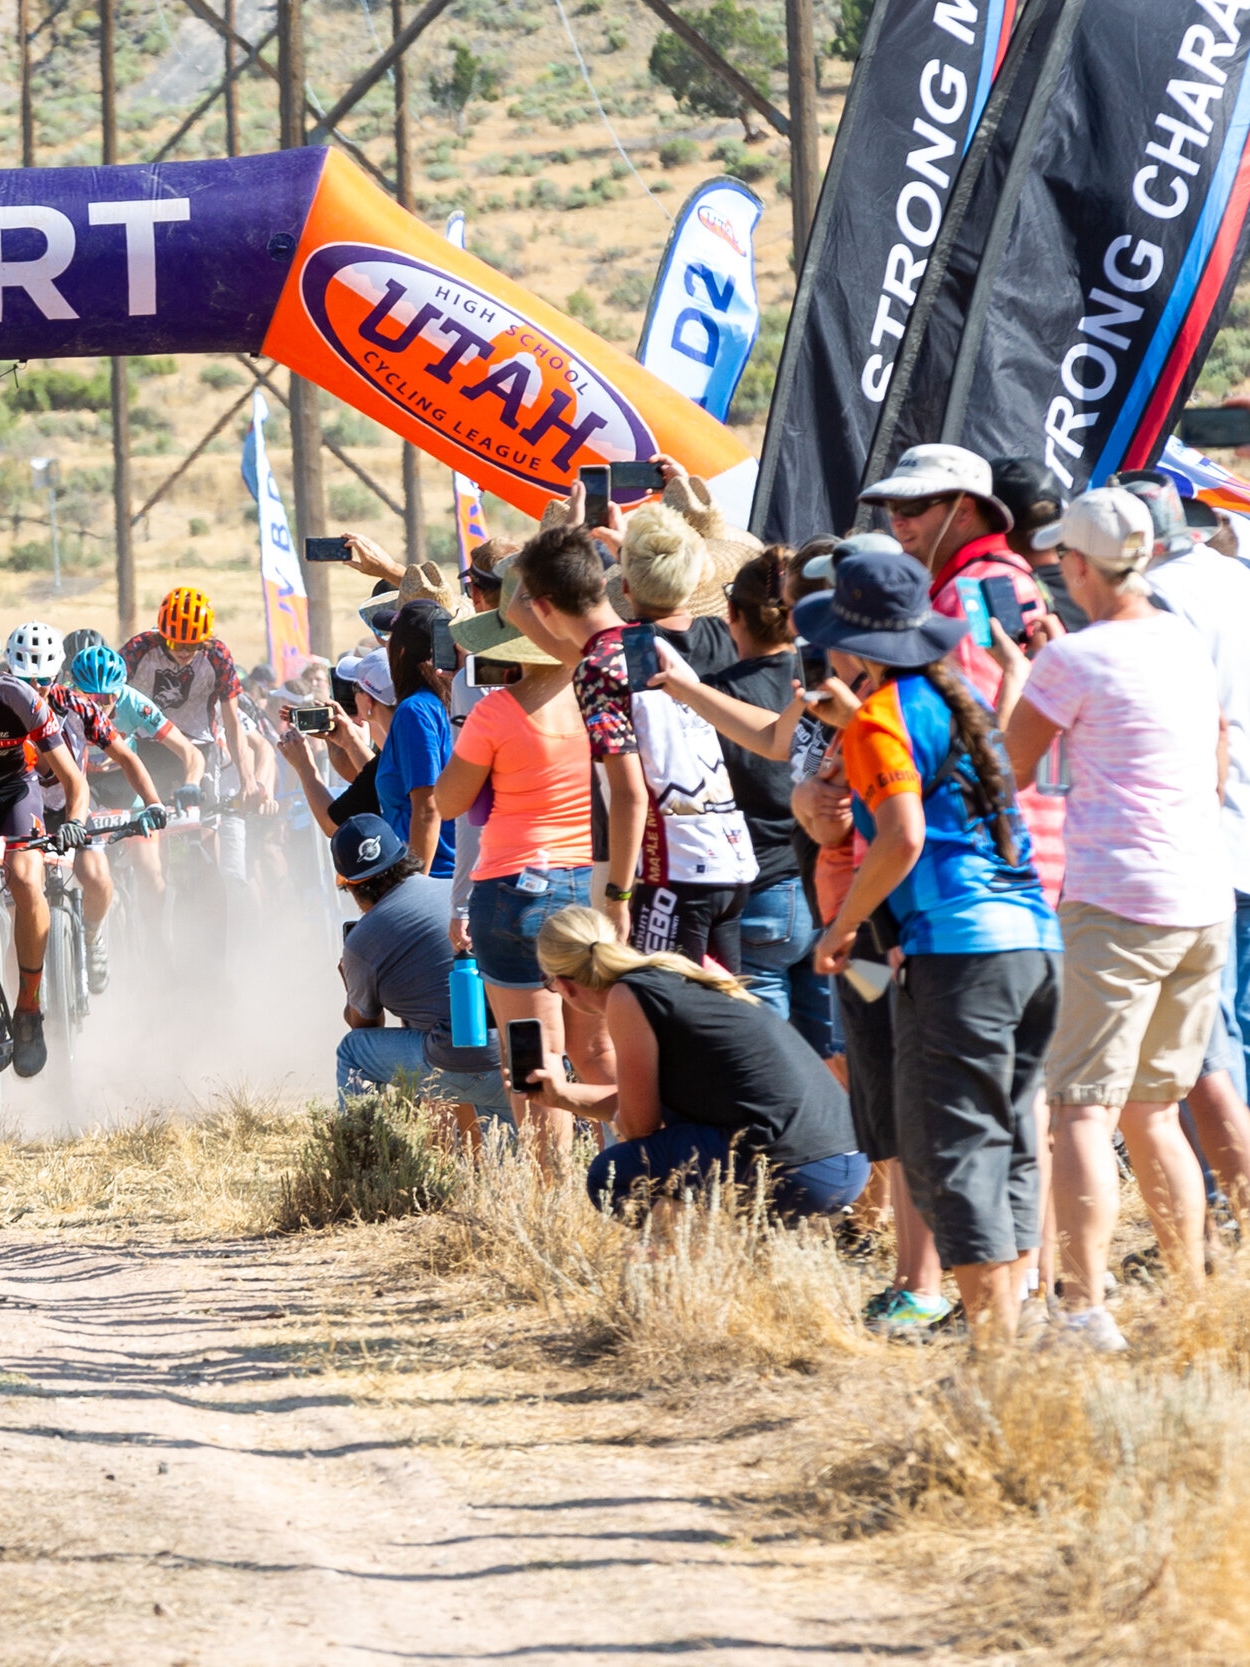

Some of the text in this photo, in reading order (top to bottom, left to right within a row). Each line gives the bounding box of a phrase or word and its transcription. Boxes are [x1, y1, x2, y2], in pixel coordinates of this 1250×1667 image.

[861, 58, 968, 403] STRONG
[435, 285, 589, 395] HIGH SCHOOL
[671, 263, 736, 369] D2
[1044, 234, 1164, 489] TRONG
[358, 278, 608, 473] UTAH
[364, 350, 541, 471] CYCLING LEAGUE
[93, 815, 122, 829] 303
[645, 887, 678, 956] EBO
